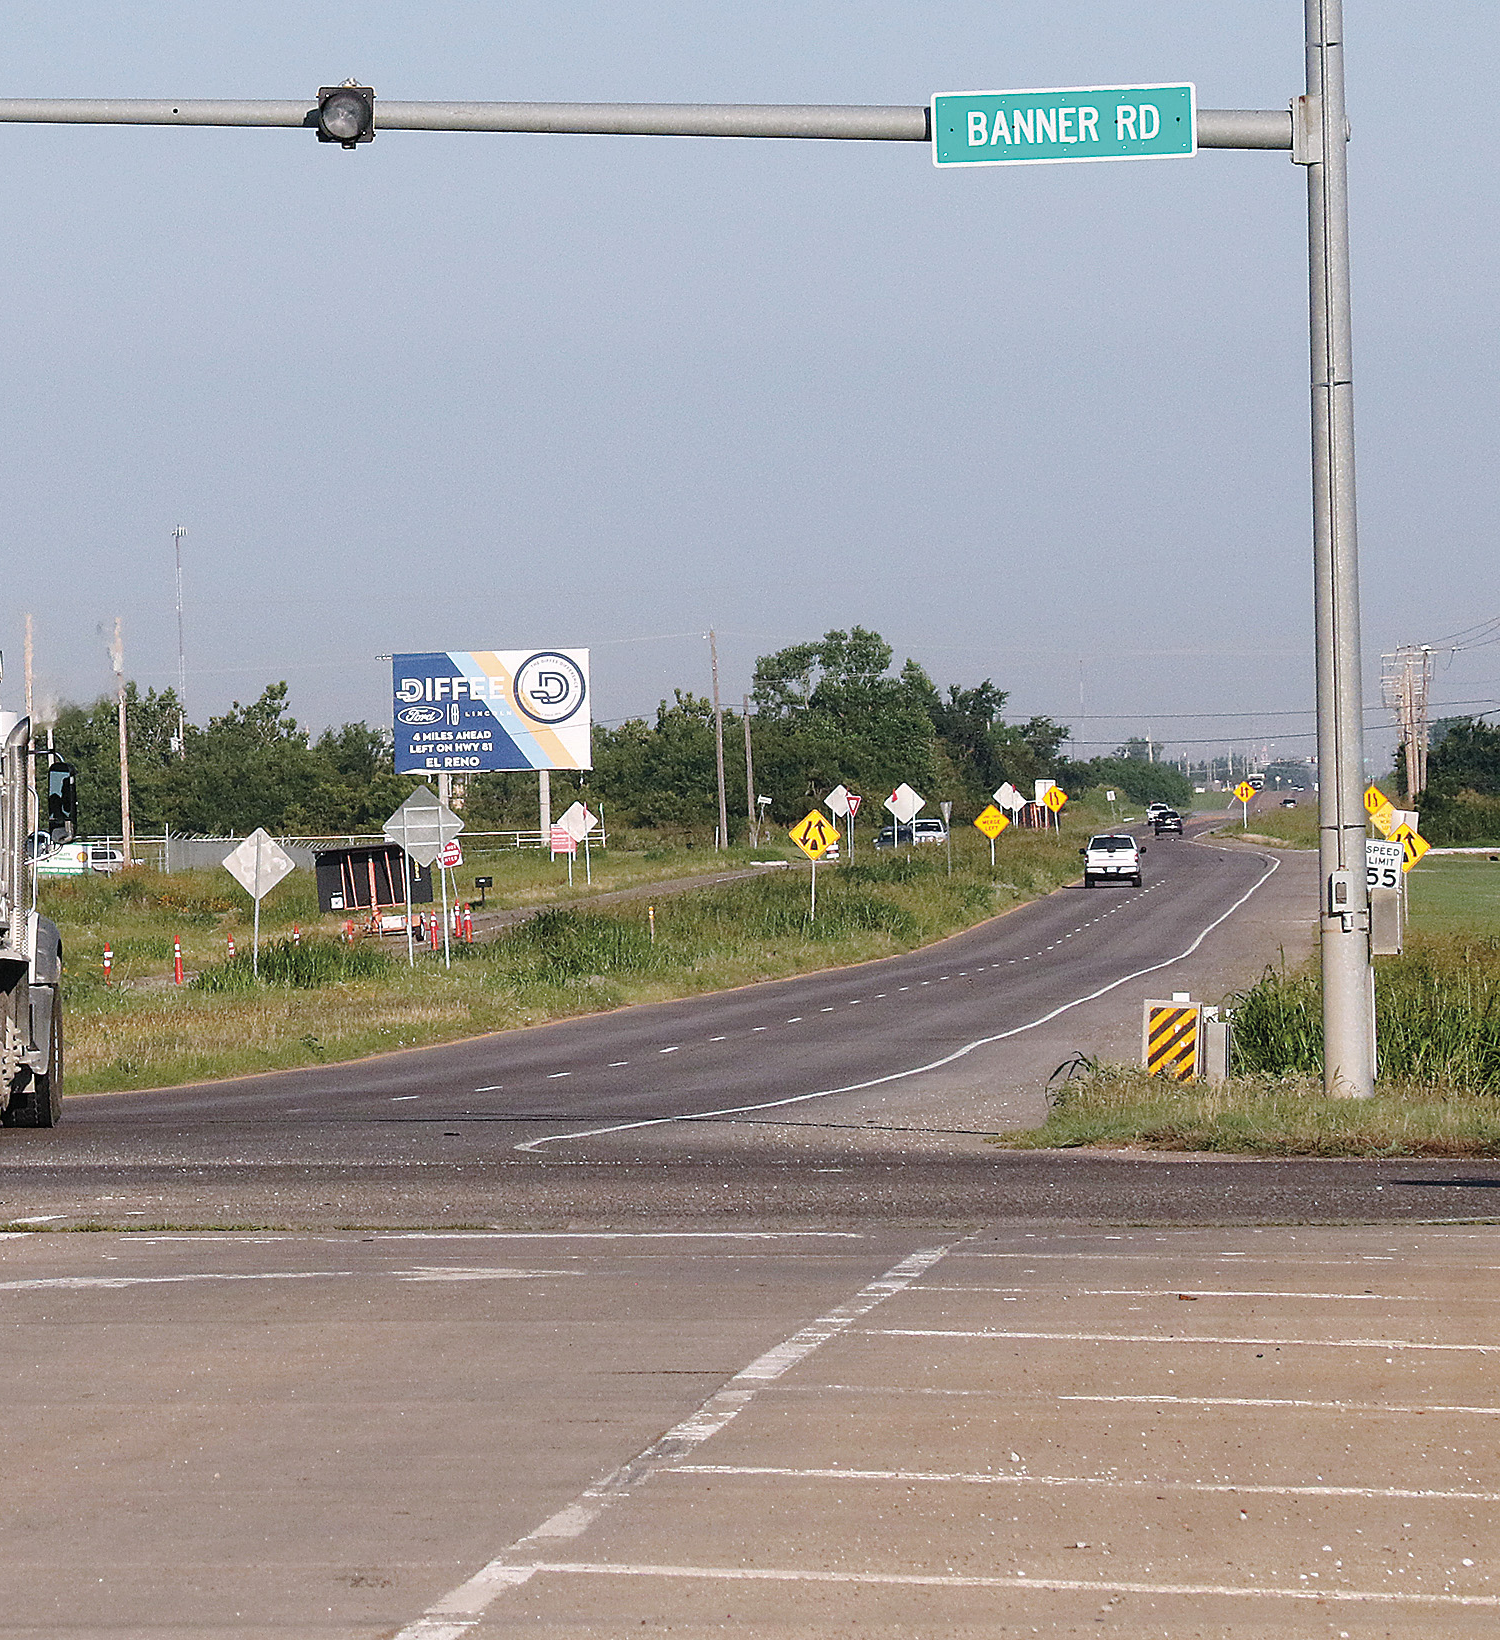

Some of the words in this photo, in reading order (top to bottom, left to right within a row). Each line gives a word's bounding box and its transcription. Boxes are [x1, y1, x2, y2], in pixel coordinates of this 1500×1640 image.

[967, 106, 1099, 147] BANNER
[1116, 104, 1160, 141] RD
[396, 676, 505, 702] DIFFEE
[405, 708, 437, 722] Ford
[464, 710, 512, 718] LINCOLN
[412, 732, 421, 742] 4
[422, 731, 454, 741] MILES
[455, 730, 492, 740] AHEAD
[409, 744, 435, 754] LEFT
[436, 743, 453, 753] ON
[454, 742, 480, 752] HWY
[481, 742, 493, 752] 81
[425, 757, 442, 768] EL
[444, 756, 481, 768] RENO
[1366, 845, 1400, 857] SPEED
[1368, 856, 1395, 866] LIMIT
[1366, 867, 1397, 888] 55
